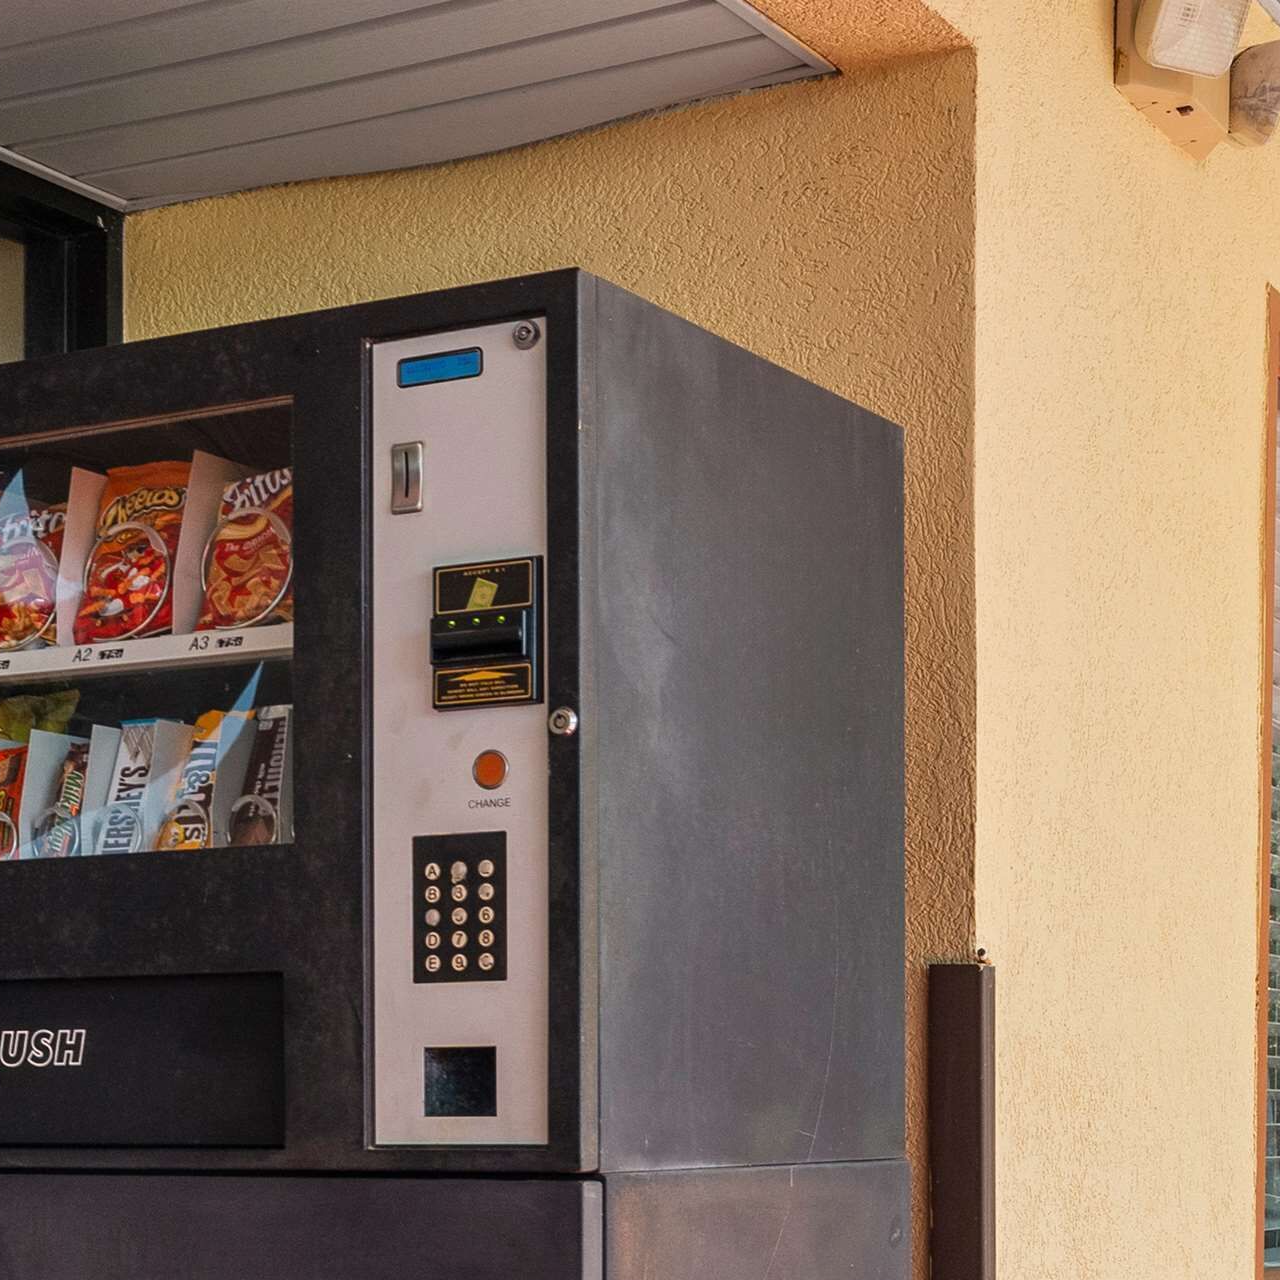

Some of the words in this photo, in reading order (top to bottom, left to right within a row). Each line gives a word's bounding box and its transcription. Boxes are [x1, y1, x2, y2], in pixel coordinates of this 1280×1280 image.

[189, 635, 210, 651] A3
[72, 647, 93, 662] A2
[102, 764, 151, 854] ERSHEY'S
[468, 797, 511, 809] CHANGE
[428, 865, 437, 876] A
[428, 888, 437, 900] B
[482, 909, 490, 921] 6
[428, 934, 438, 946] D
[455, 933, 463, 945] 7
[482, 932, 490, 944] 8
[428, 957, 437, 969] E
[455, 956, 464, 968] 9
